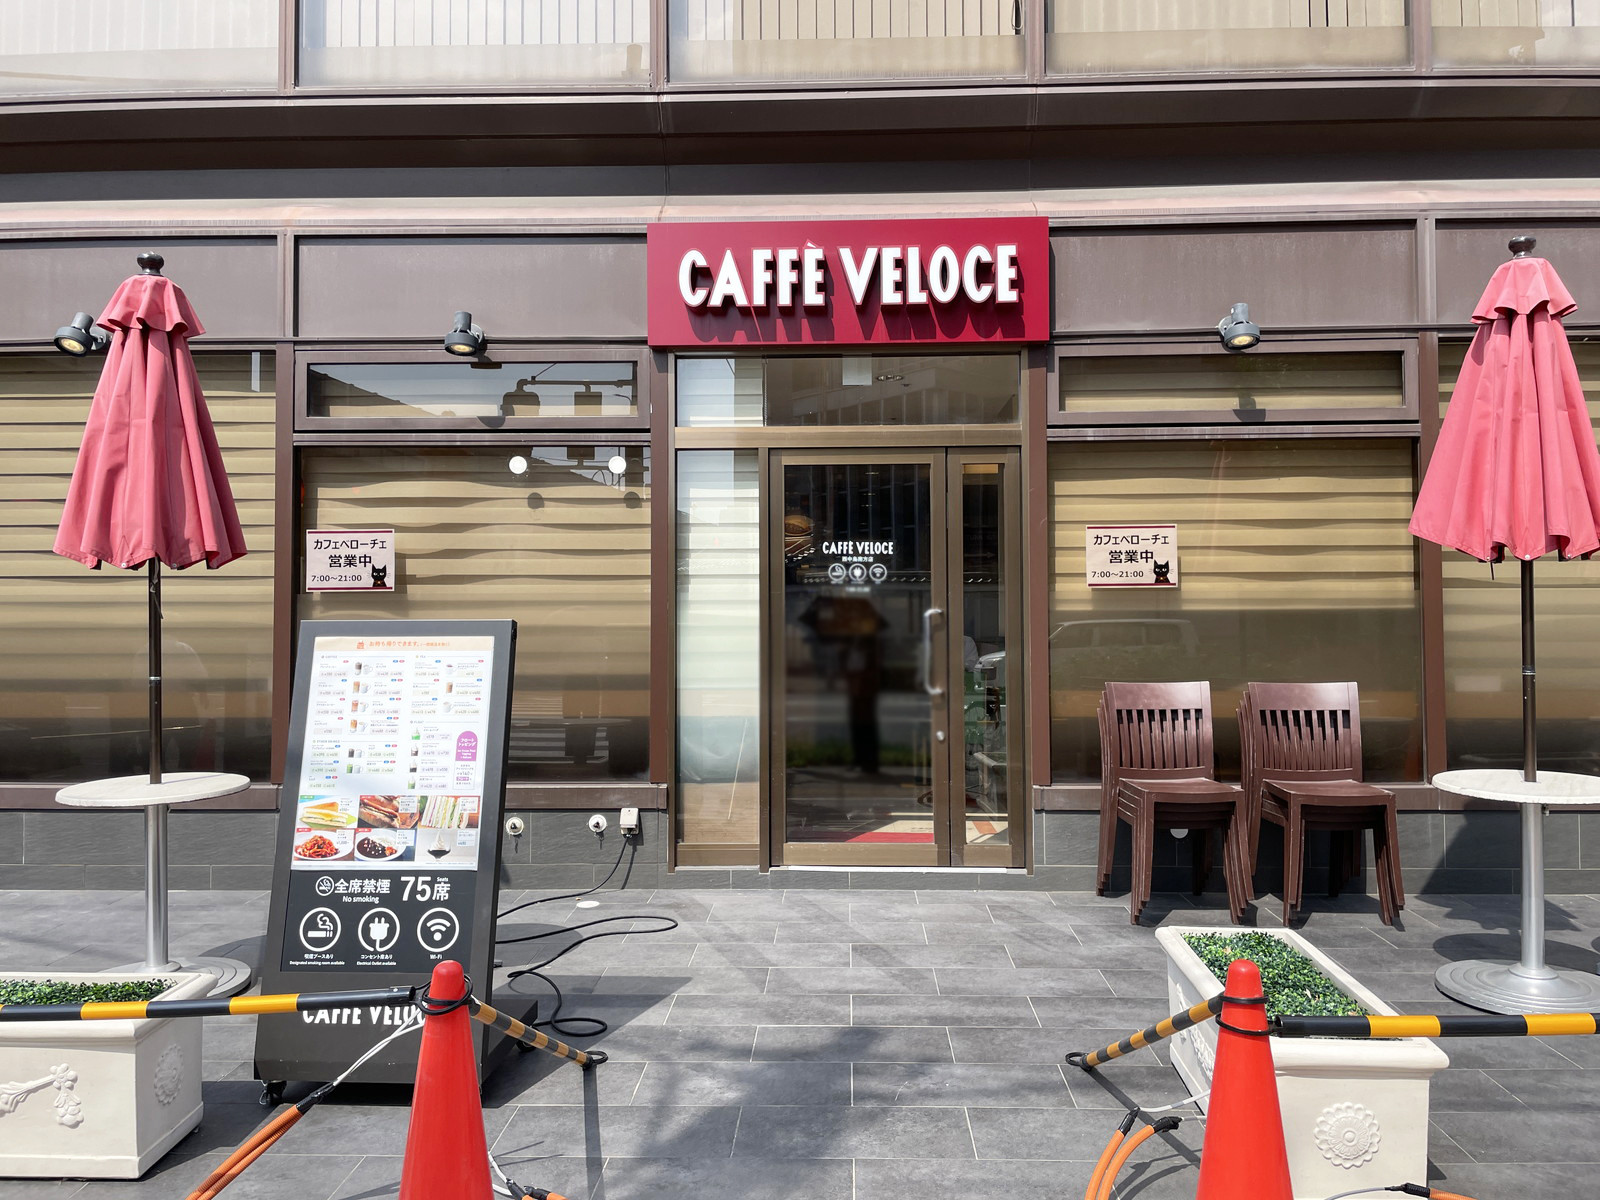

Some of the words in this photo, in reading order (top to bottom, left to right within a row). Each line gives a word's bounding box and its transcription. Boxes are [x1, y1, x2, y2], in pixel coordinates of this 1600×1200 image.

[679, 240, 825, 306] CAFFÈ
[838, 244, 1018, 305] VELOCE
[314, 539, 387, 550] カフェベローチェ
[1093, 534, 1169, 545] カフェベローチェ
[822, 541, 853, 554] CAFFÈ
[856, 541, 894, 554] VELOCE
[328, 554, 372, 568] 営業中
[1109, 550, 1153, 563] 営業中
[334, 878, 391, 894] 全席禁煙
[342, 895, 352, 903] No
[353, 896, 380, 904] smoking
